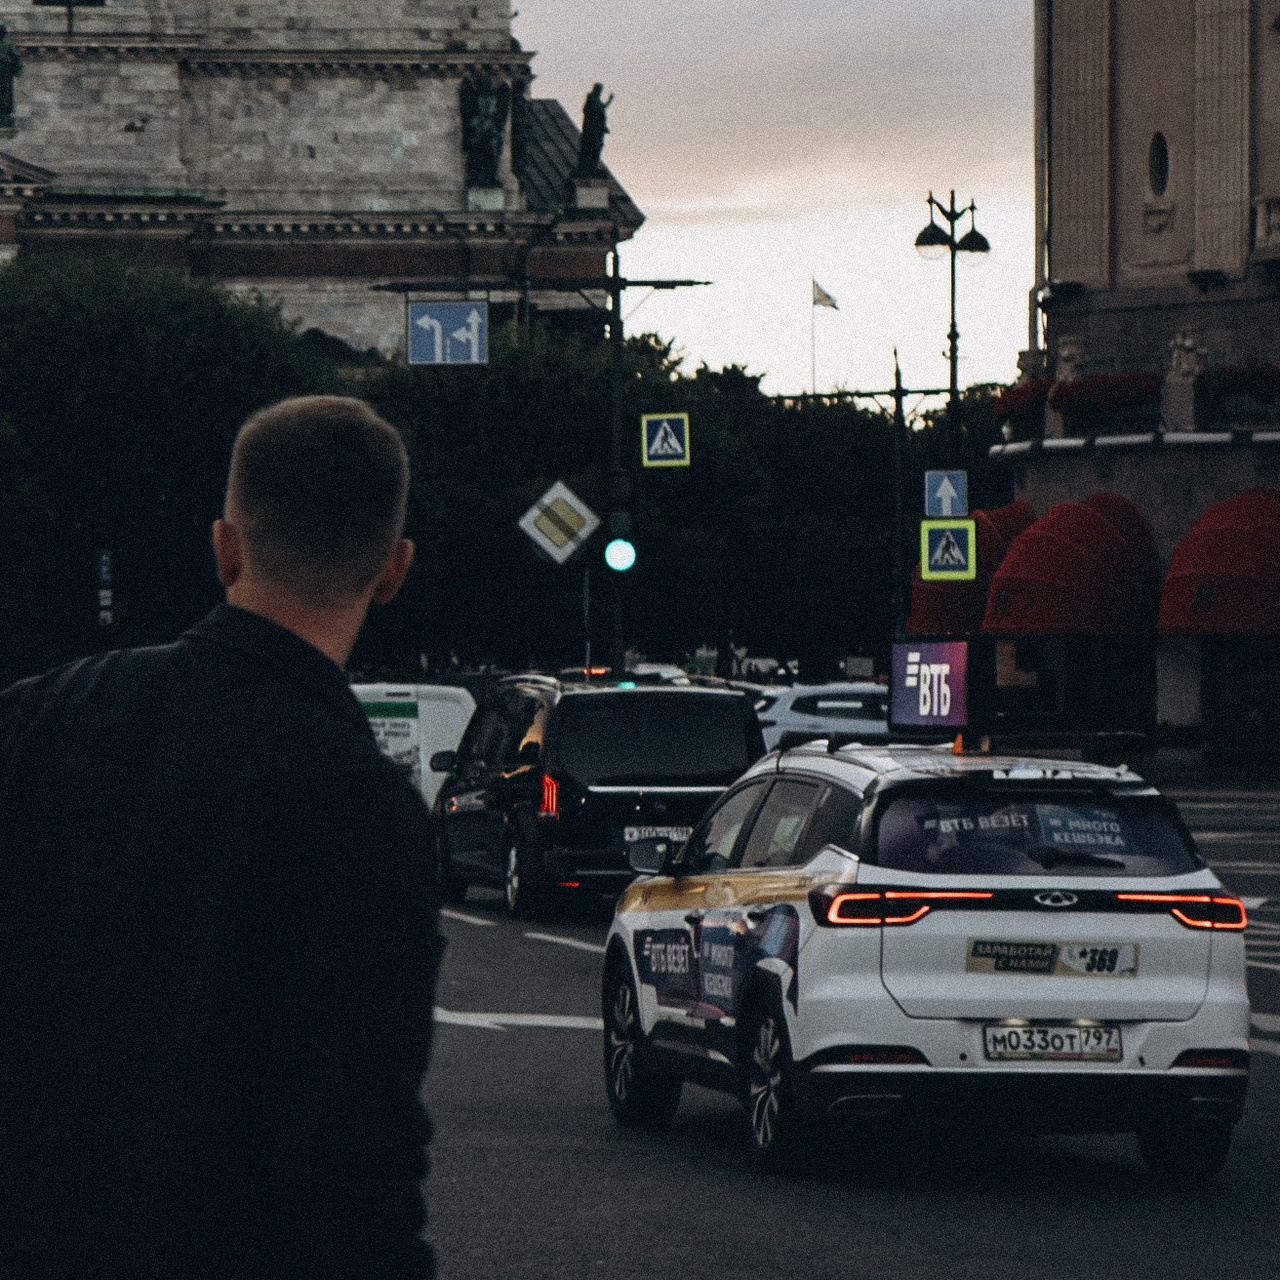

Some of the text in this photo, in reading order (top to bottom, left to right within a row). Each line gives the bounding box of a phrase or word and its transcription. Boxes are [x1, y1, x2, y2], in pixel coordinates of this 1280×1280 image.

[918, 663, 952, 717] ВТБ
[939, 817, 975, 833] ВТБ
[1068, 818, 1121, 833] МНОГО
[1052, 831, 1126, 847] КЕШБЭКА
[976, 942, 1054, 957] ЗАРАБОТАЙ
[1009, 957, 1050, 970] НАМИ
[991, 1028, 1115, 1051] М033ОТ 797
